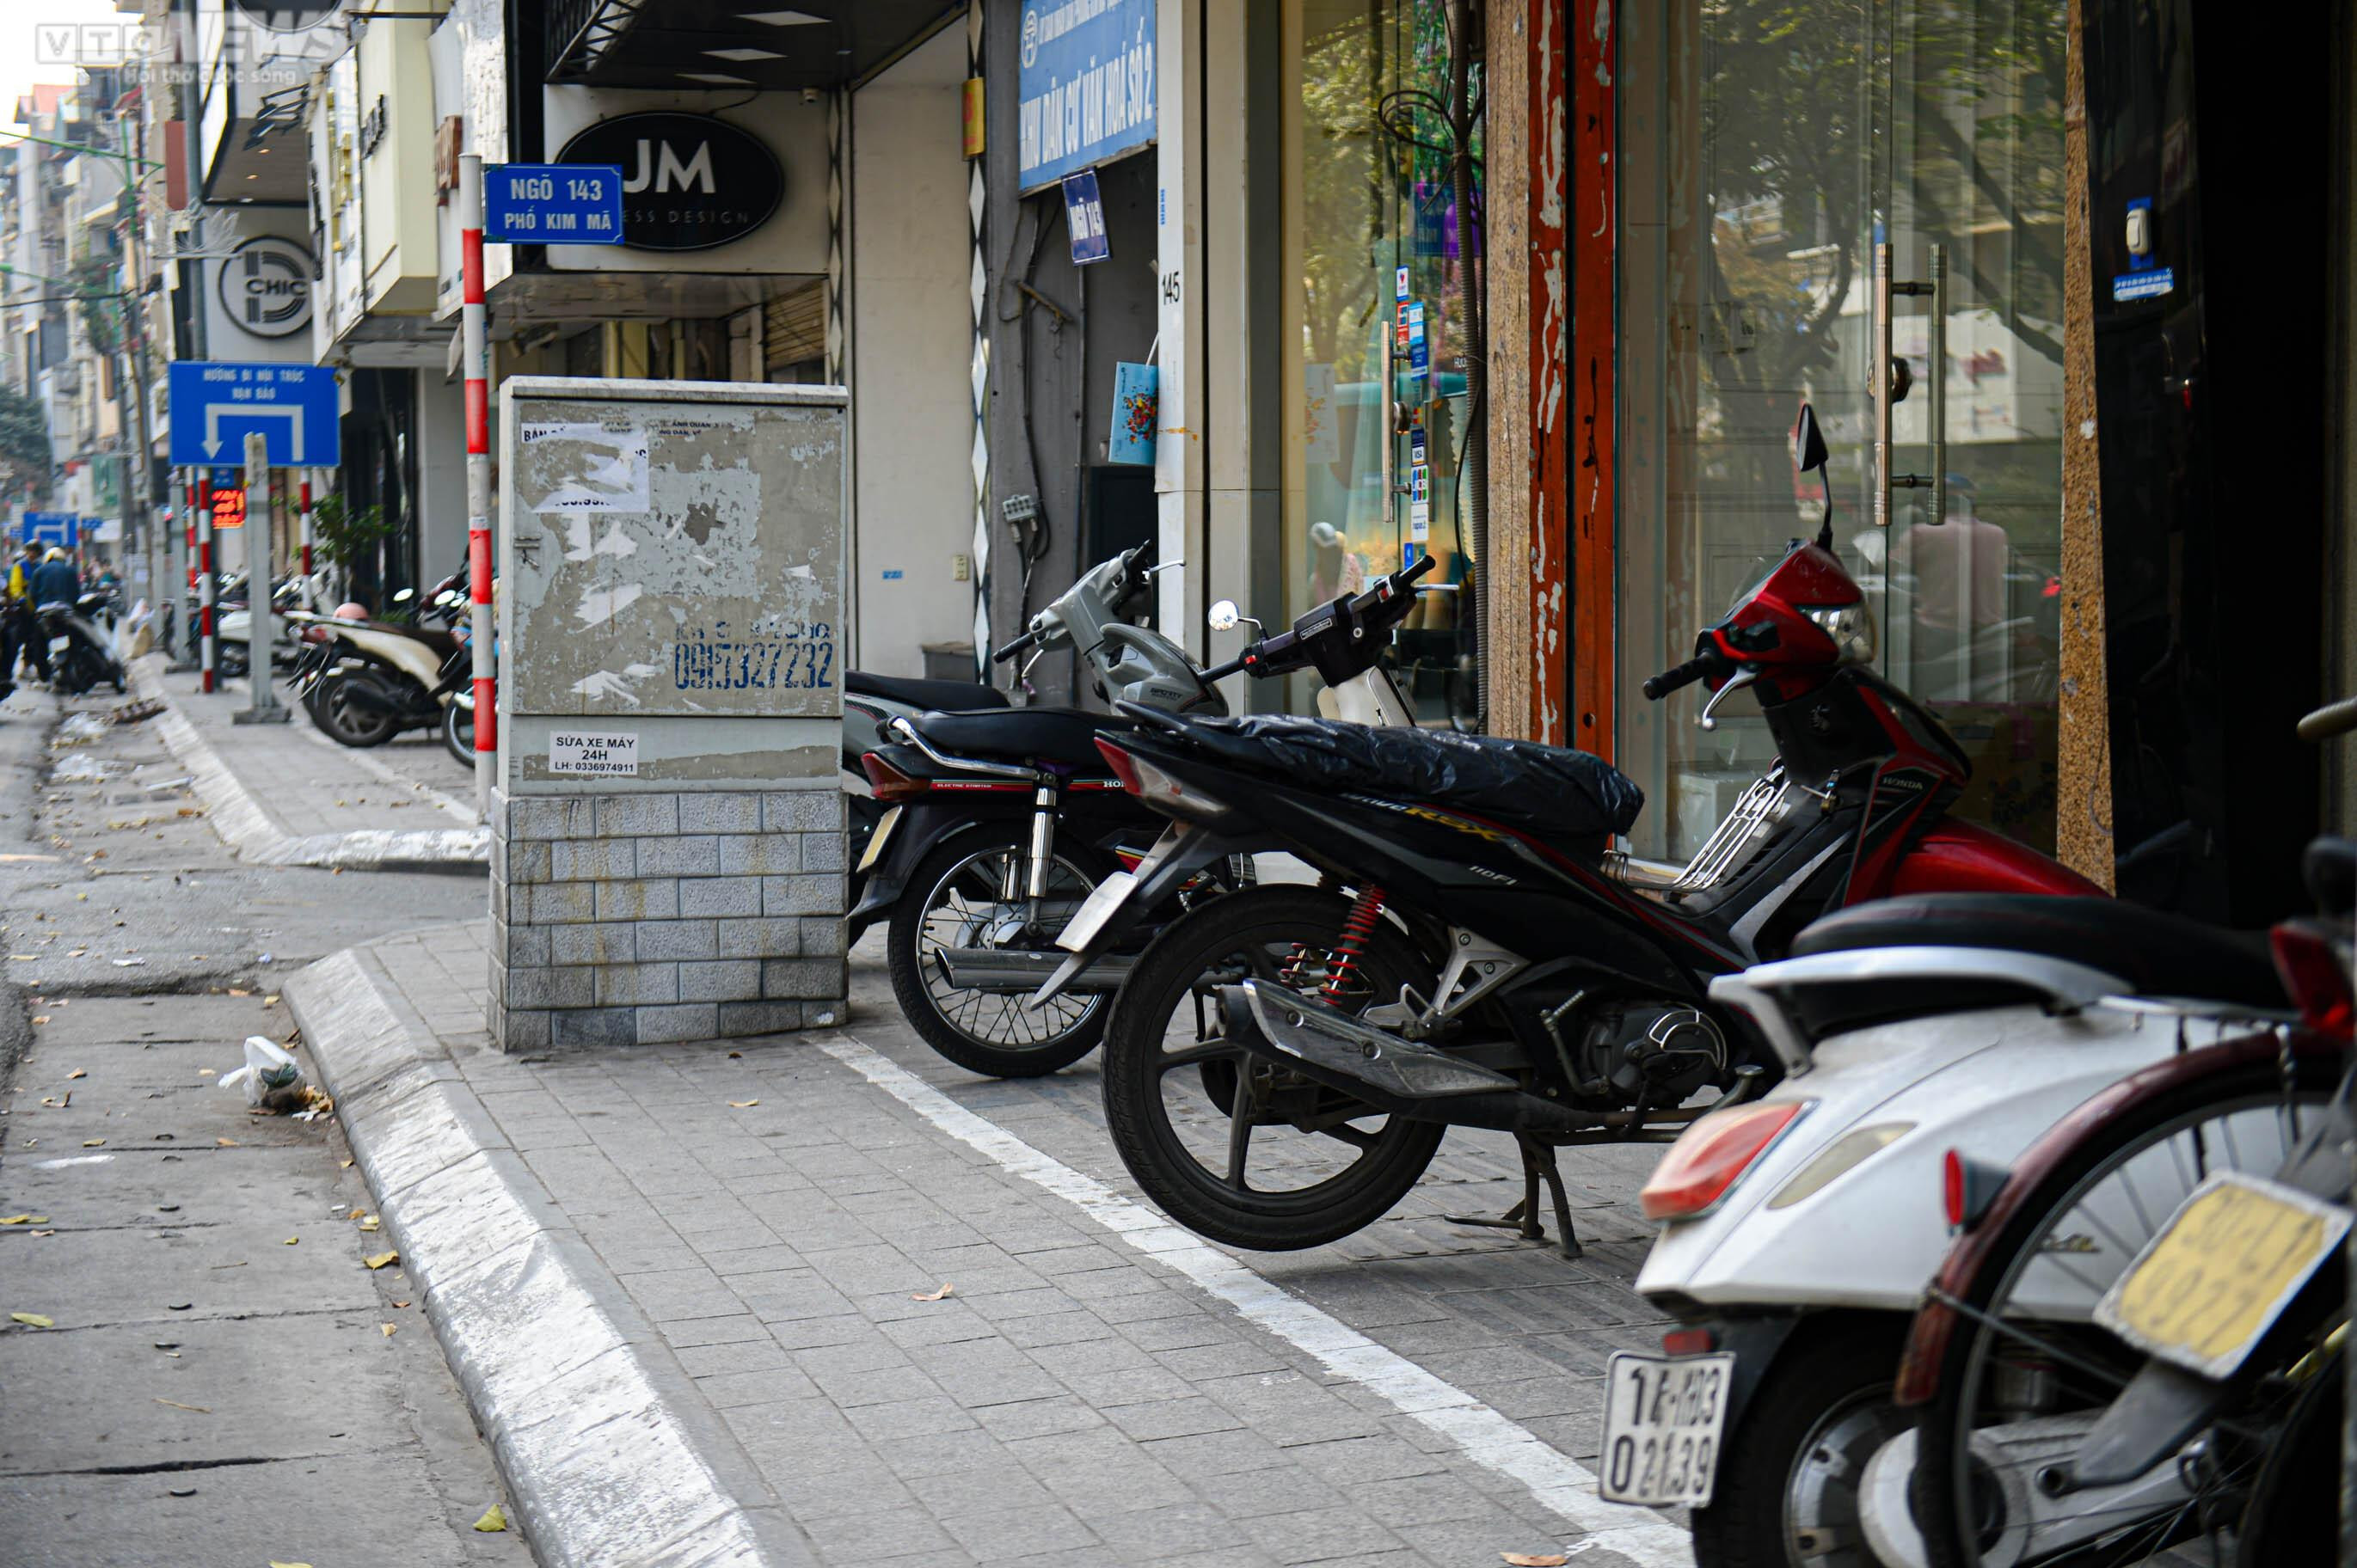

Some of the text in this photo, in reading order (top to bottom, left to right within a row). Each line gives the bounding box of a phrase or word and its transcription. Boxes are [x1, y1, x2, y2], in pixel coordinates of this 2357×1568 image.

[1127, 16, 1145, 127] SỐ
[1144, 41, 1152, 120] 2
[623, 138, 716, 194] JM
[510, 173, 603, 201] NGÕ 143
[504, 205, 612, 230] PHỐ KIM MÃ
[668, 210, 749, 224] DESIGN
[246, 278, 307, 296] CHIC
[1162, 271, 1181, 305] 145
[555, 734, 635, 749] SỬA XE MÁY
[581, 750, 608, 761] 24H
[555, 762, 634, 772] LH: 0336974911
[1882, 776, 1924, 790] HONDA
